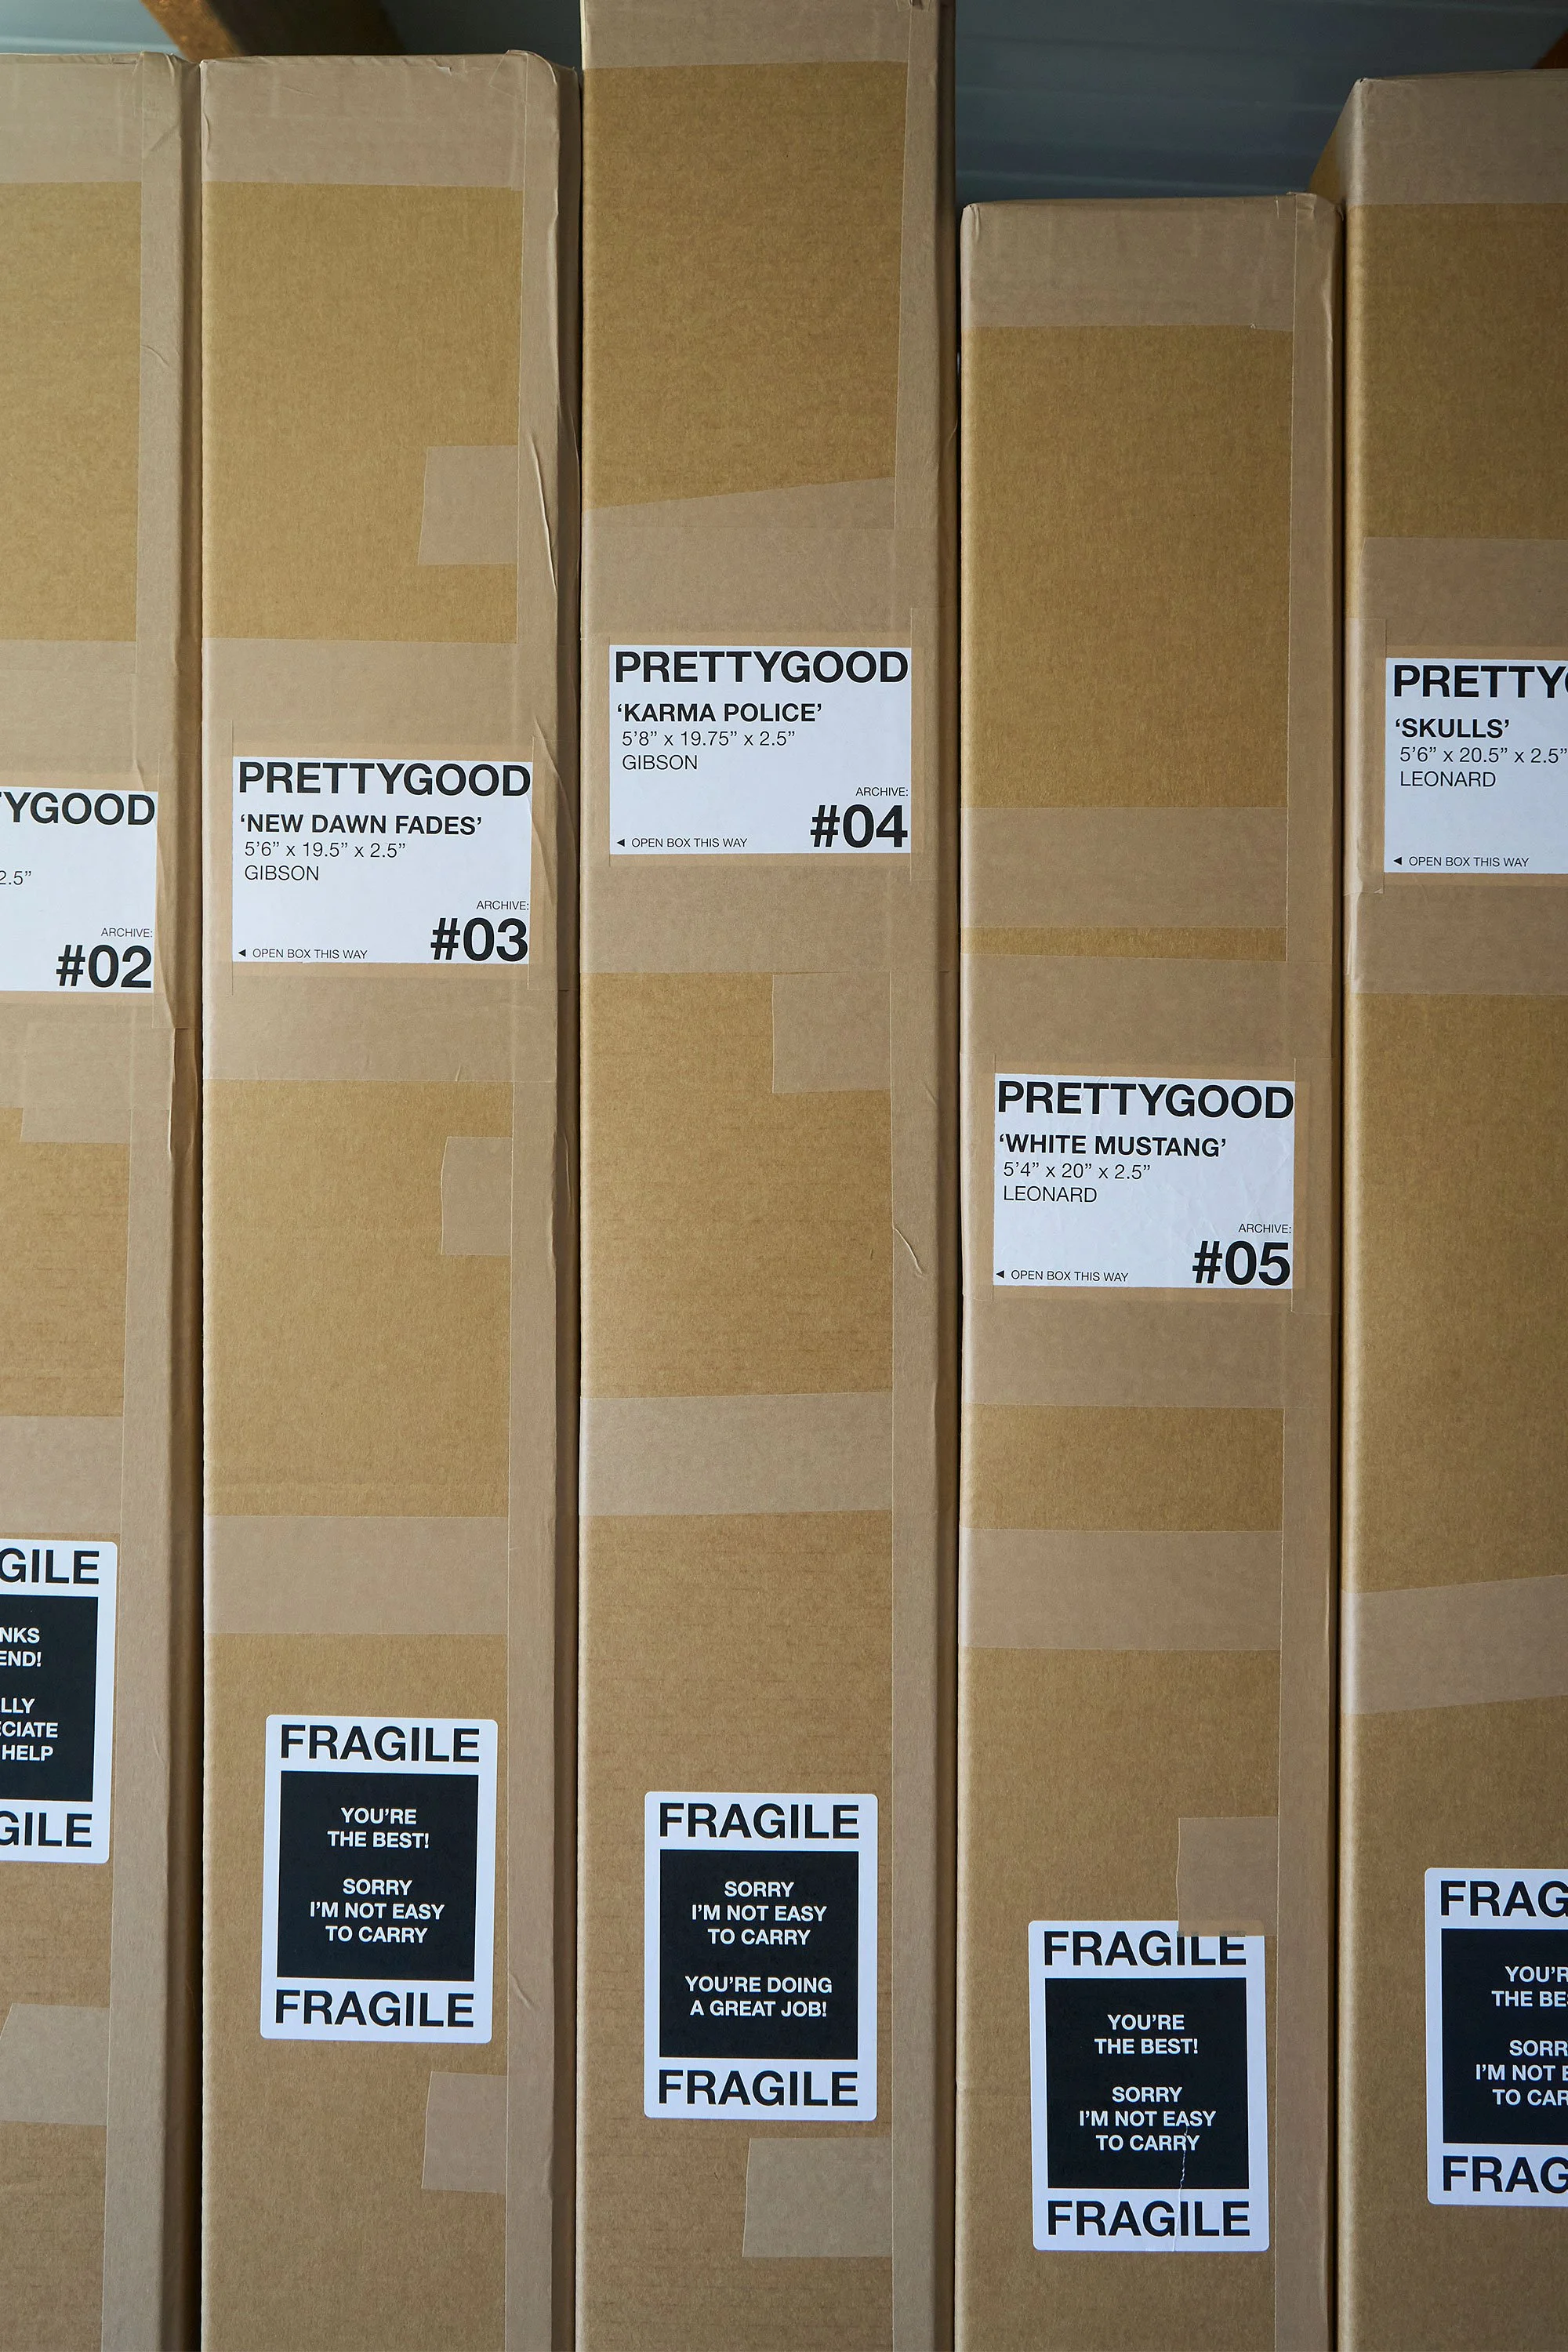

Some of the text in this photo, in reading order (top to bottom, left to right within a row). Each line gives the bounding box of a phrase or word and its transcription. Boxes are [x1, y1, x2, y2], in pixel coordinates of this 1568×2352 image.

[616, 651, 908, 683] PRETTYGOOD
[1395, 665, 1568, 698] PRETTY
[618, 703, 821, 722] ‘KARMA POLICE’
[1396, 718, 1508, 738] ‘SKULLS’
[622, 731, 794, 746] 5’8” x 19.75” x 2.5”
[622, 755, 697, 770] GIBSON
[1400, 747, 1566, 763] 5’6” x 20.5” x 2.5”
[240, 762, 530, 796] PRETTYGOOD
[1401, 771, 1495, 786] LEONARD
[856, 787, 908, 796] ARCHIVE:
[0, 792, 154, 825] YGOOD
[241, 814, 481, 835] ‘NEW DAWN FADES’
[811, 804, 908, 848] #04
[245, 842, 405, 858] 5’6” x 19.5” x 2.5”
[632, 838, 747, 847] OPEN BOX THIS WAY
[1409, 856, 1529, 866] OPEN BOX THIS WAY
[245, 866, 318, 880] GIBSON
[477, 901, 528, 909] ARCHIVE:
[101, 928, 152, 937] ARCHIVE:
[431, 918, 528, 961] #03
[253, 949, 367, 959] OPEN BOX THIS WAY
[56, 945, 151, 988] #02
[999, 1081, 1294, 1118] PRETTYGOOD
[1000, 1134, 1225, 1157] ‘WHITE MUSTANG’
[1004, 1162, 1150, 1179] 5’4” x 20” x 2.5”
[1004, 1185, 1097, 1202] LEONARD
[1239, 1224, 1291, 1233] ARCHIVE:
[1192, 1241, 1290, 1286] #05
[1011, 1270, 1128, 1281] OPEN BOX THIS WAY
[281, 1725, 479, 1762] FRAGILE
[2, 1745, 53, 1761] HELP
[341, 1808, 416, 1824] YOU’RE
[660, 1803, 858, 1838] FRAGILE
[328, 1831, 429, 1848] THE BEST!
[343, 1878, 412, 1895] SORRY
[724, 1881, 794, 1896] SORRY
[310, 1902, 445, 1919] I’M NOT EASY
[692, 1905, 827, 1921] I’M NOT EASY
[325, 1926, 427, 1943] TO CARRY
[708, 1929, 811, 1944] TO CARRY
[1044, 1931, 1246, 1966] FRAGILE
[685, 1976, 832, 1993] YOU’RE DOING
[1492, 1991, 1533, 2006] THE
[276, 1990, 474, 2027] FRAGILE
[690, 2000, 826, 2016] A GREAT JOB!
[1108, 2014, 1184, 2030] YOU’RE
[1094, 2038, 1197, 2054] THE BEST!
[1476, 2064, 1504, 2080] I’M
[1513, 2065, 1555, 2081] NOT
[659, 2070, 858, 2106] FRAGILE
[1112, 2087, 1182, 2102] SORRY
[1493, 2089, 1520, 2105] TO
[1080, 2111, 1216, 2126] I’M NOT EASY
[1096, 2135, 1200, 2151] TO CARRY
[1048, 2201, 1250, 2237] FRAGILE
